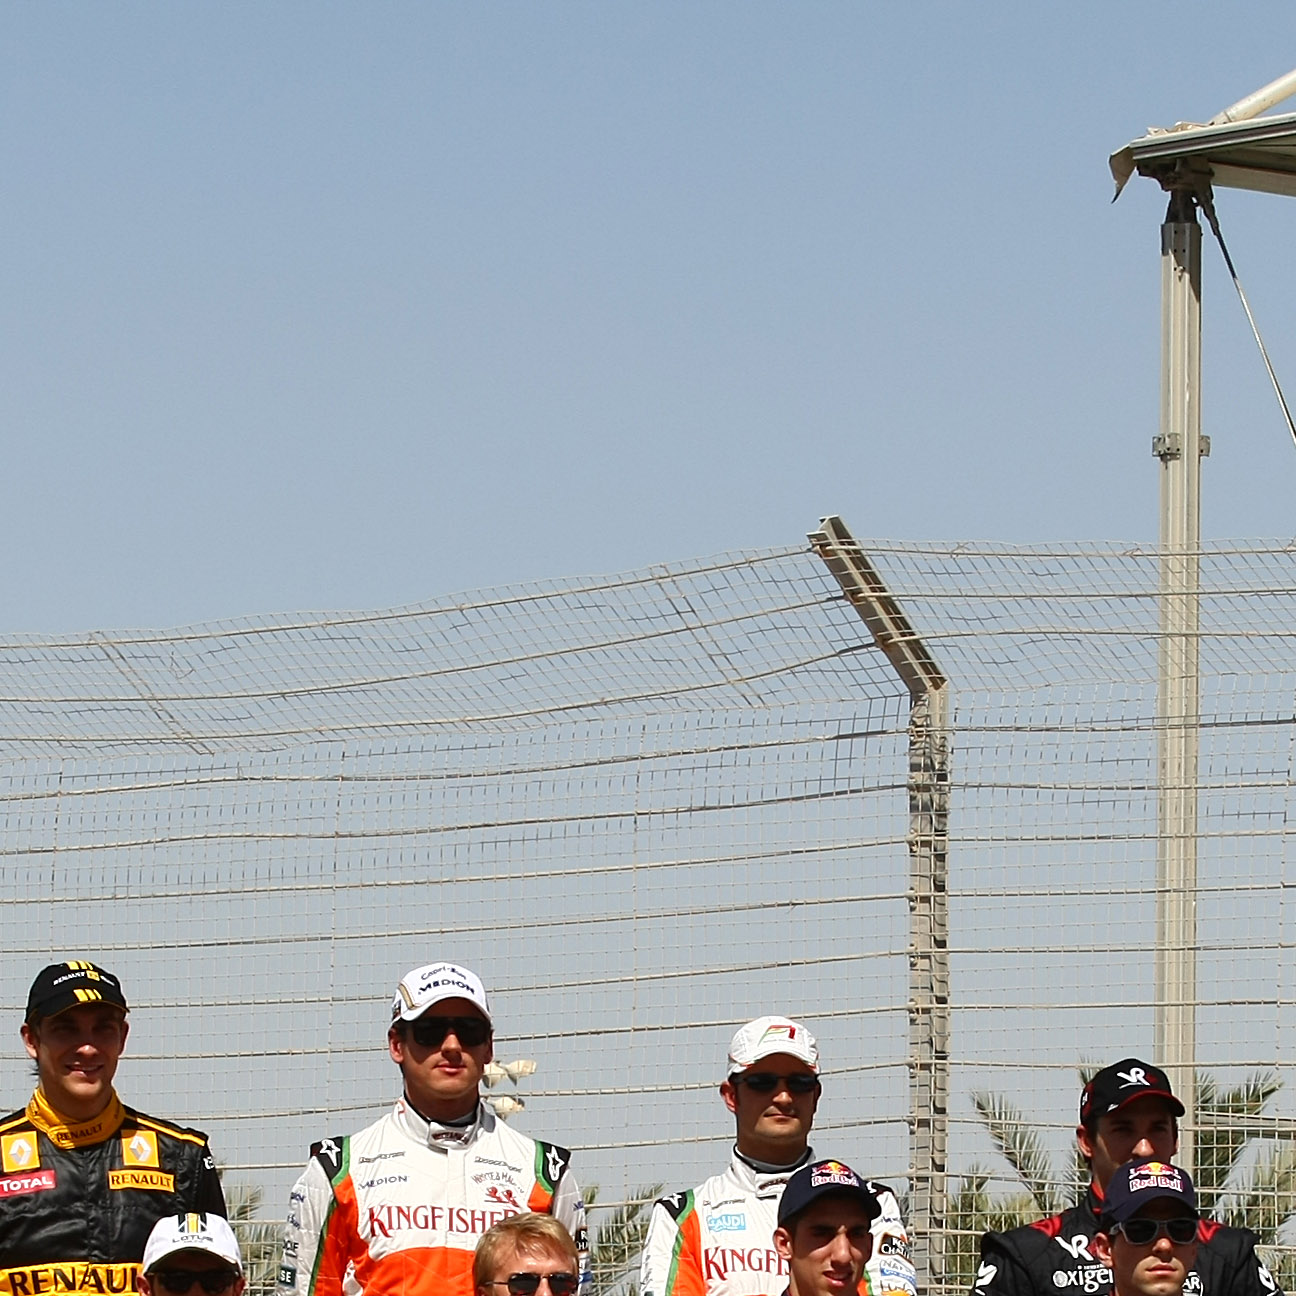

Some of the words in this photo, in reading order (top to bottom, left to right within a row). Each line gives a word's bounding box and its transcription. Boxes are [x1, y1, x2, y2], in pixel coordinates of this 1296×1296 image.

[0, 1175, 52, 1192] TOTAL
[111, 1174, 171, 1190] RENAULT
[704, 1246, 790, 1280] KINGFI
[9, 1268, 138, 1296] RENAUL
